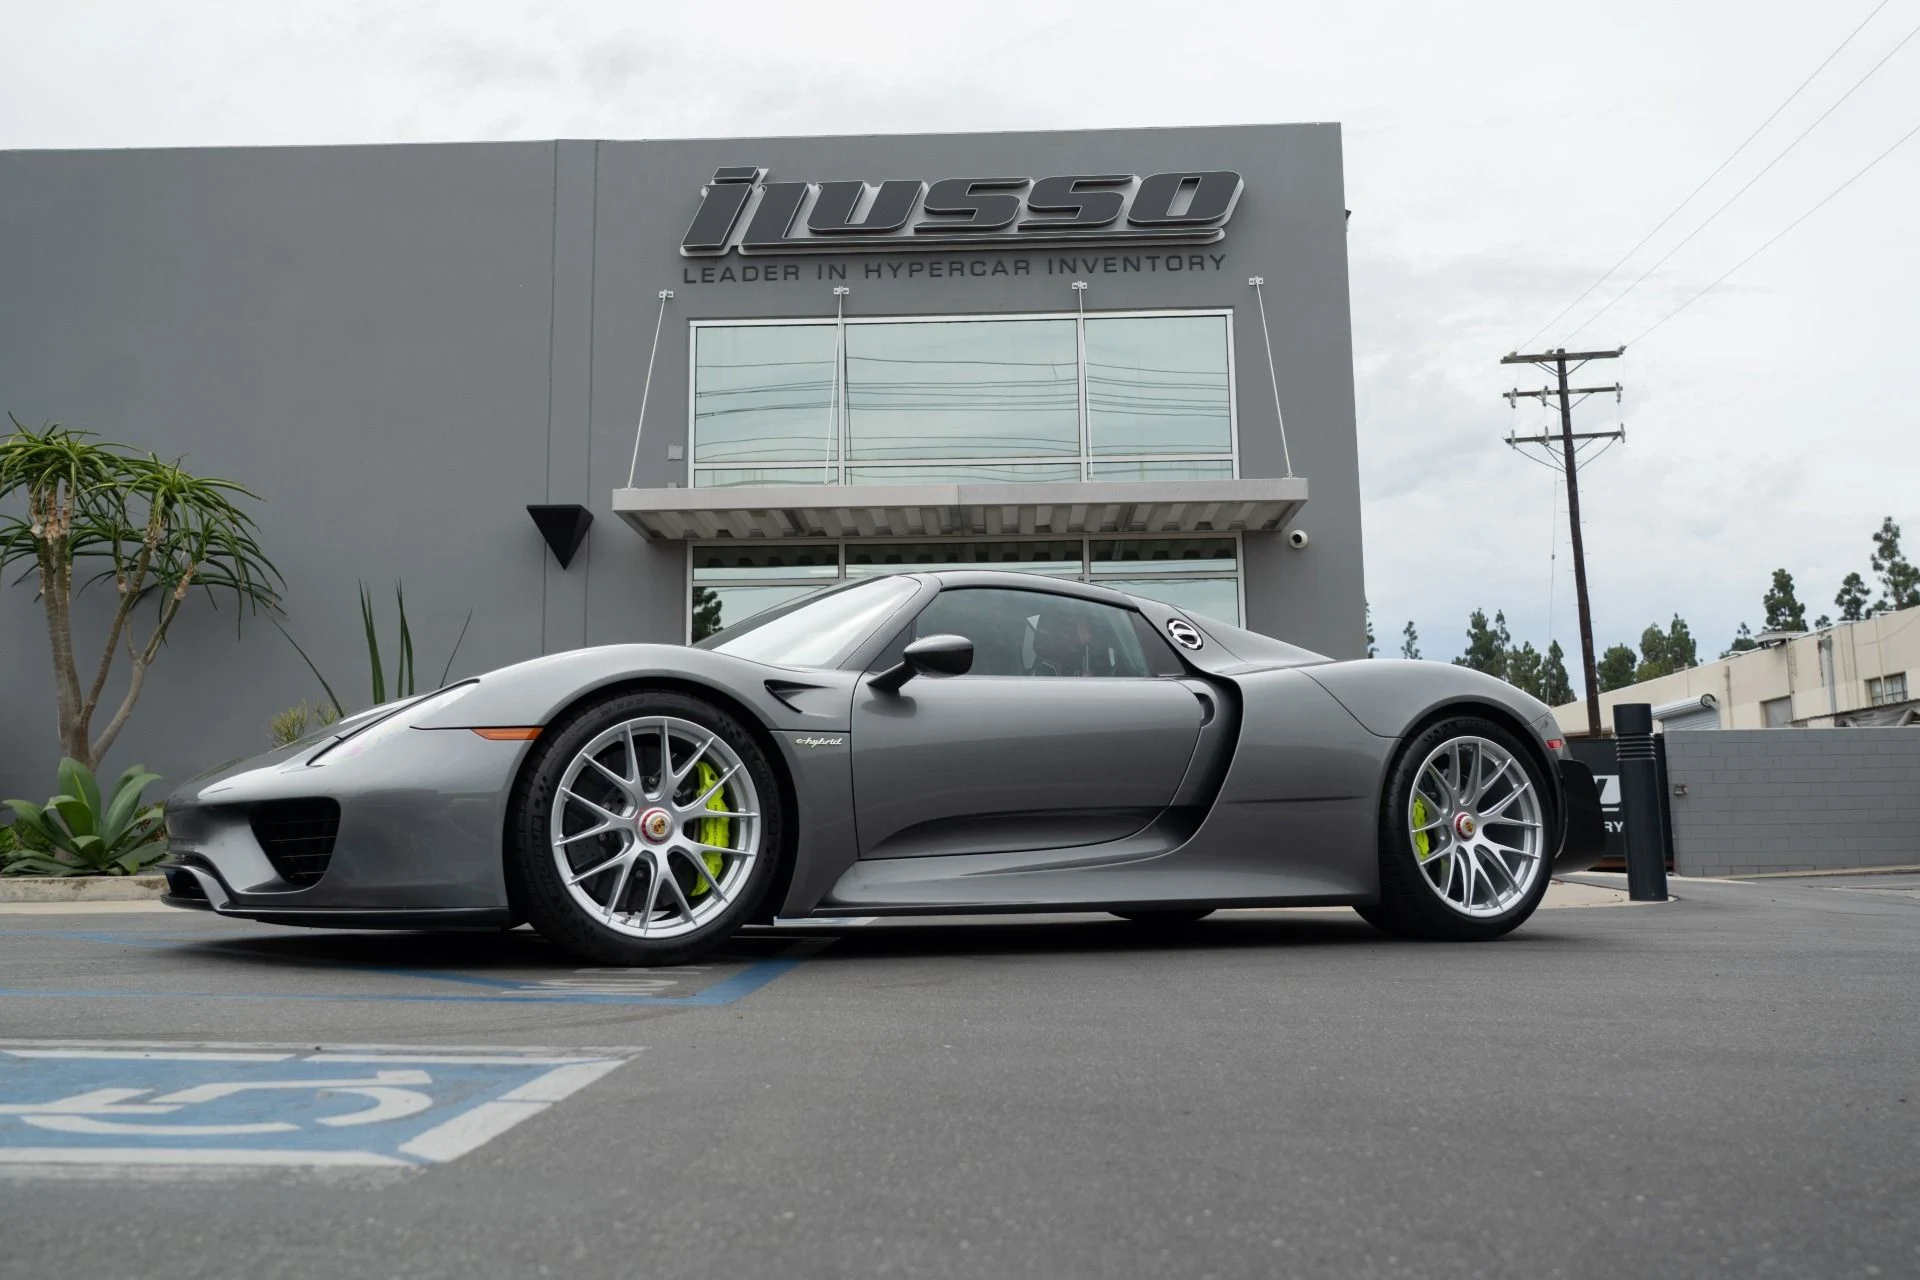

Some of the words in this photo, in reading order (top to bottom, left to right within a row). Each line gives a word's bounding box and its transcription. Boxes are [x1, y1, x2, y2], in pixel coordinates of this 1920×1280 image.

[683, 265, 800, 284] LEADER
[817, 263, 847, 281] IN
[864, 258, 1031, 280] HYPERCAR
[1048, 253, 1226, 275] INVENTORY
